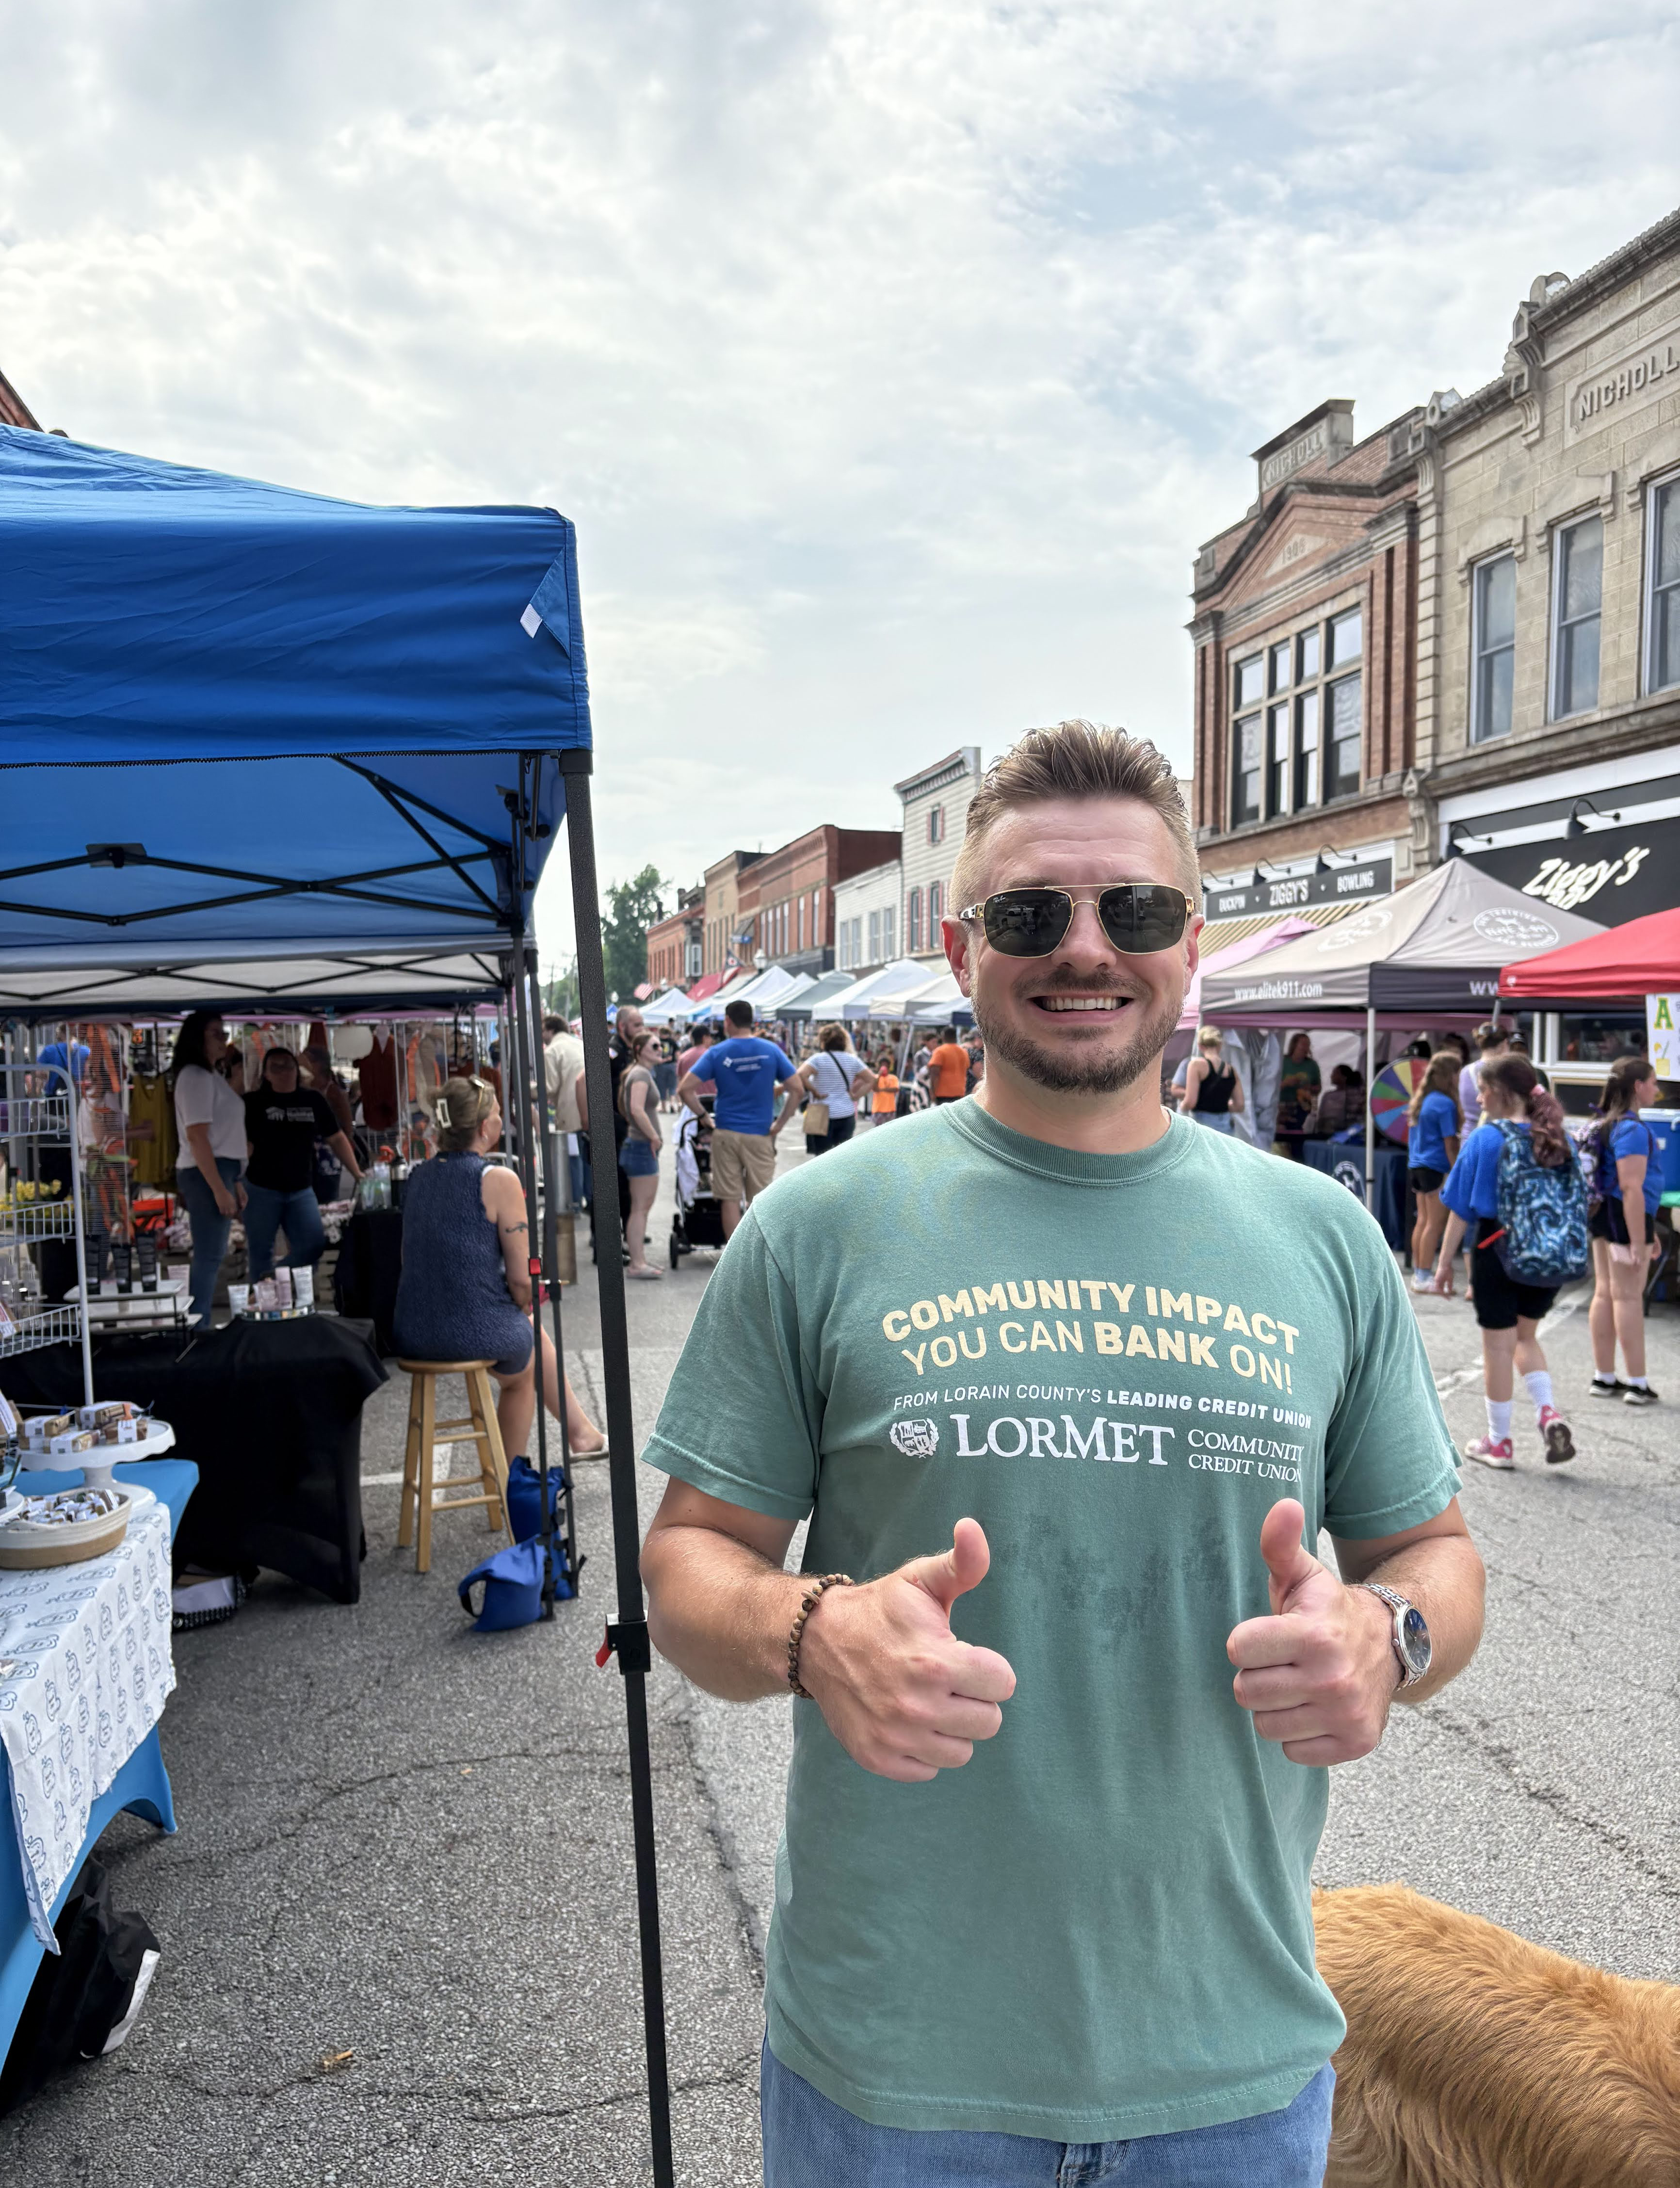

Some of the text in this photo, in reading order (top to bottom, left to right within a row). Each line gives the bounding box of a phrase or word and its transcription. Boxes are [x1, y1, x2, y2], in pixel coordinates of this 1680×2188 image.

[1219, 870, 1375, 913] DUCKPIN ZIGGY'S BOWLING
[1522, 846, 1650, 910] Ziggy's
[1235, 980, 1323, 1001] www.elitek911.com
[882, 1280, 1299, 1355] COMMUNITY IMPACT
[901, 1320, 1292, 1395] YOU CAN BANK ON!
[893, 1384, 1311, 1429] FROM LORAIN COUNTY'S LEADING CREDIT UNION
[1188, 1429, 1305, 1462] COMMUNITY
[1188, 1453, 1302, 1482] CREDIT UNION
